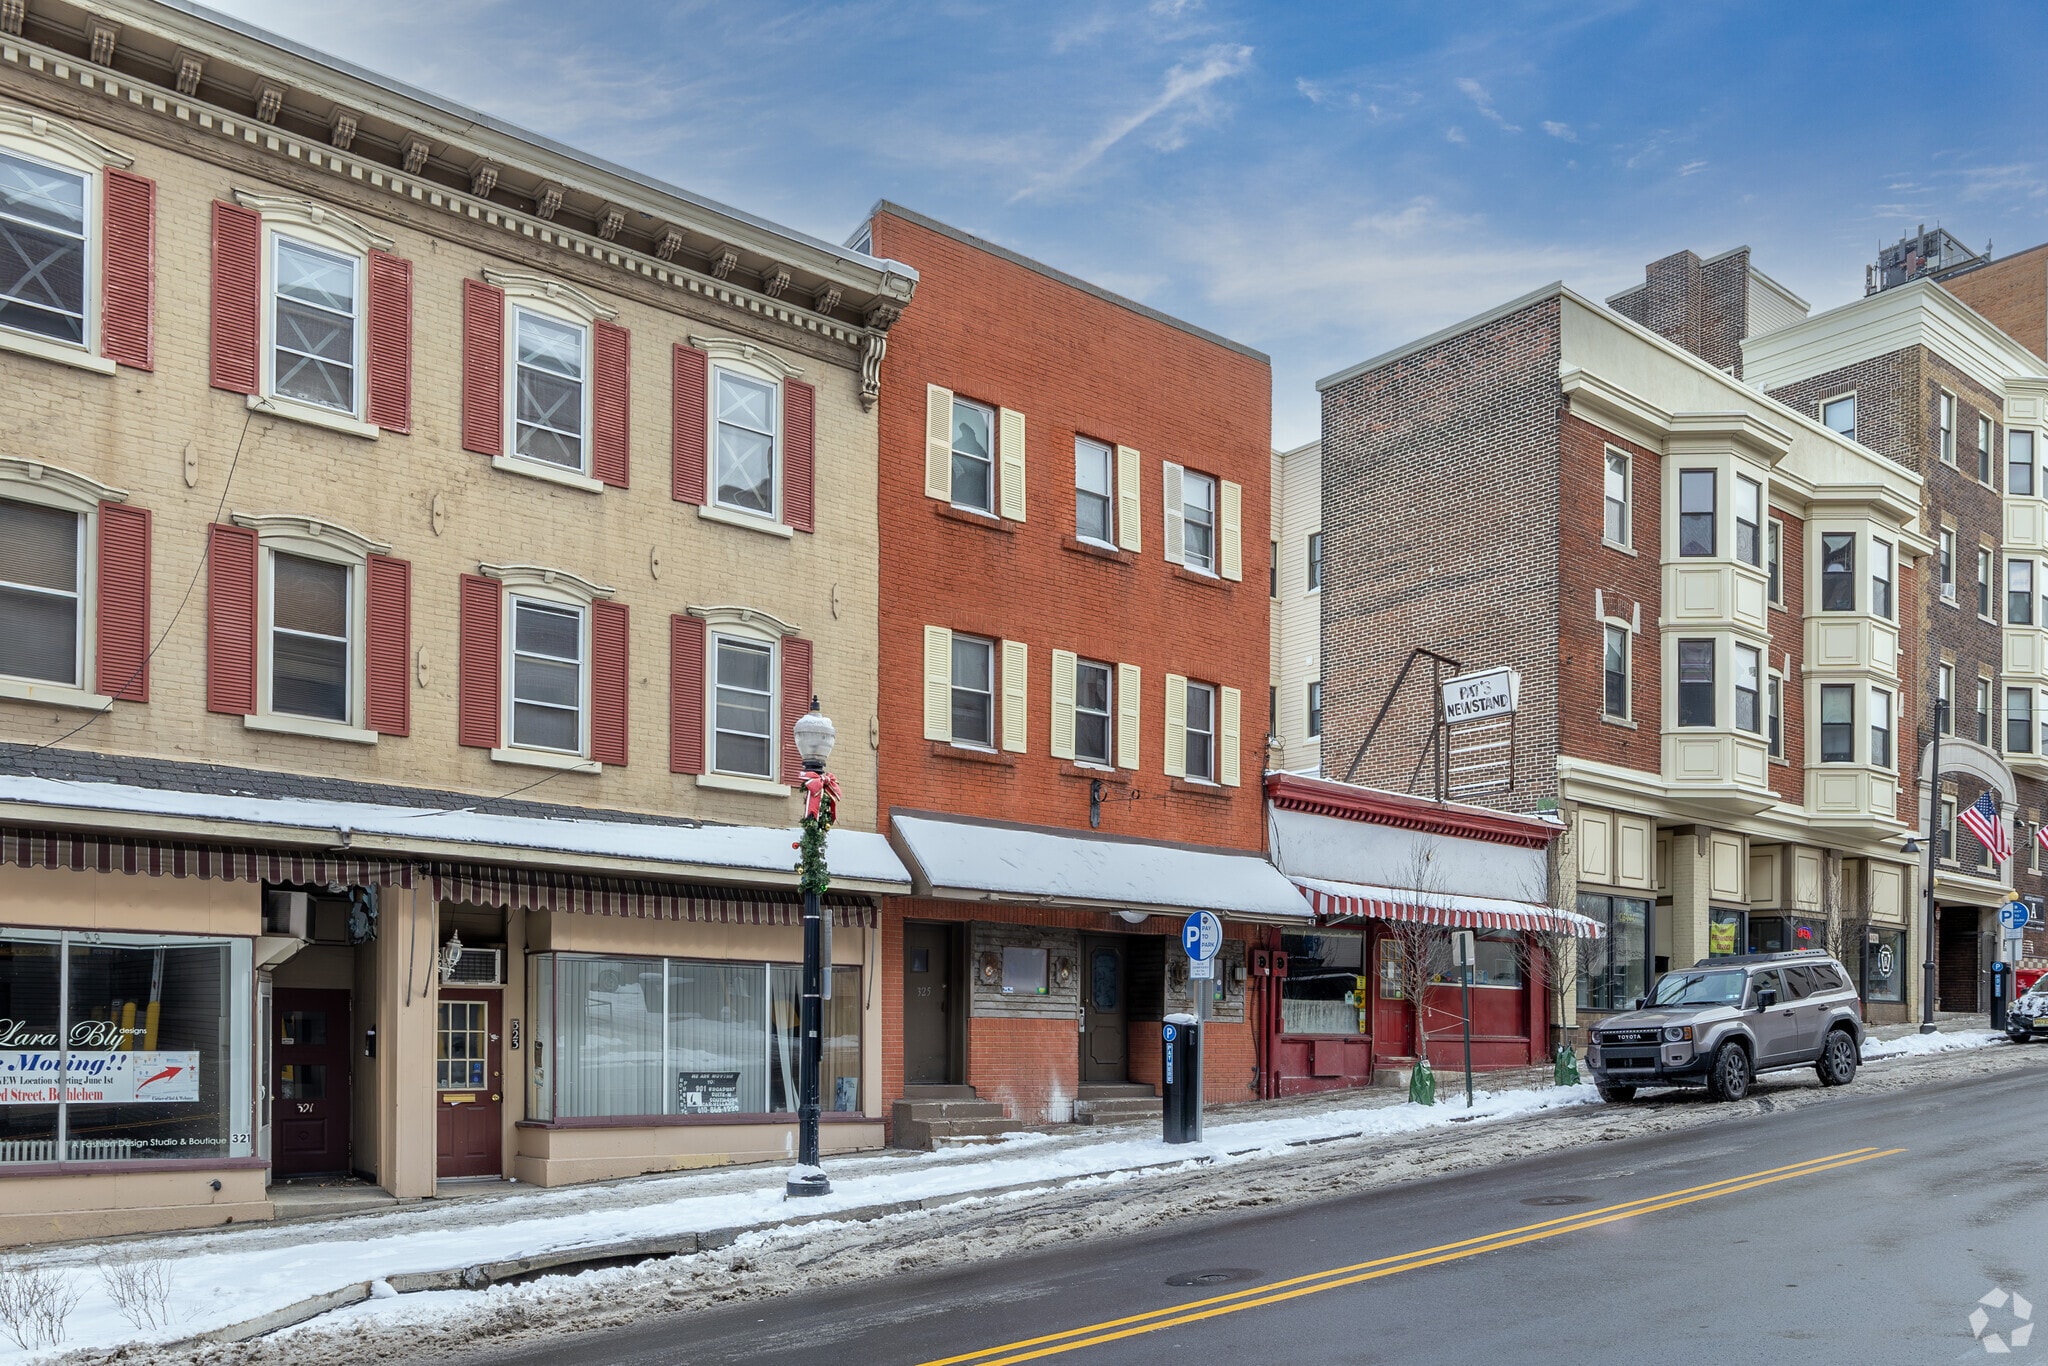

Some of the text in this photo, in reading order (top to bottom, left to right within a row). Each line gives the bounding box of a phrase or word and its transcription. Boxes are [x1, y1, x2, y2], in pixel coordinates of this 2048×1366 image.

[1460, 681, 1491, 700] PAT'S
[1447, 694, 1508, 717] NEWSTAND
[2002, 911, 2012, 923] P
[1186, 926, 1200, 949] P
[0, 1018, 127, 1054] Lara Bly
[119, 1027, 148, 1036] designs
[1166, 1027, 1173, 1039] P
[20, 1075, 55, 1085] Location
[54, 1074, 83, 1086] strting
[83, 1076, 102, 1085] June
[11, 1089, 45, 1101] Street,
[49, 1087, 103, 1101] Behlehem
[296, 1103, 314, 1113] 321
[81, 1139, 116, 1149] Fashion
[118, 1138, 149, 1149] Design
[150, 1137, 178, 1146] Studio
[180, 1138, 187, 1146] &
[189, 1136, 227, 1146] Boutique
[232, 1133, 250, 1144] 321
